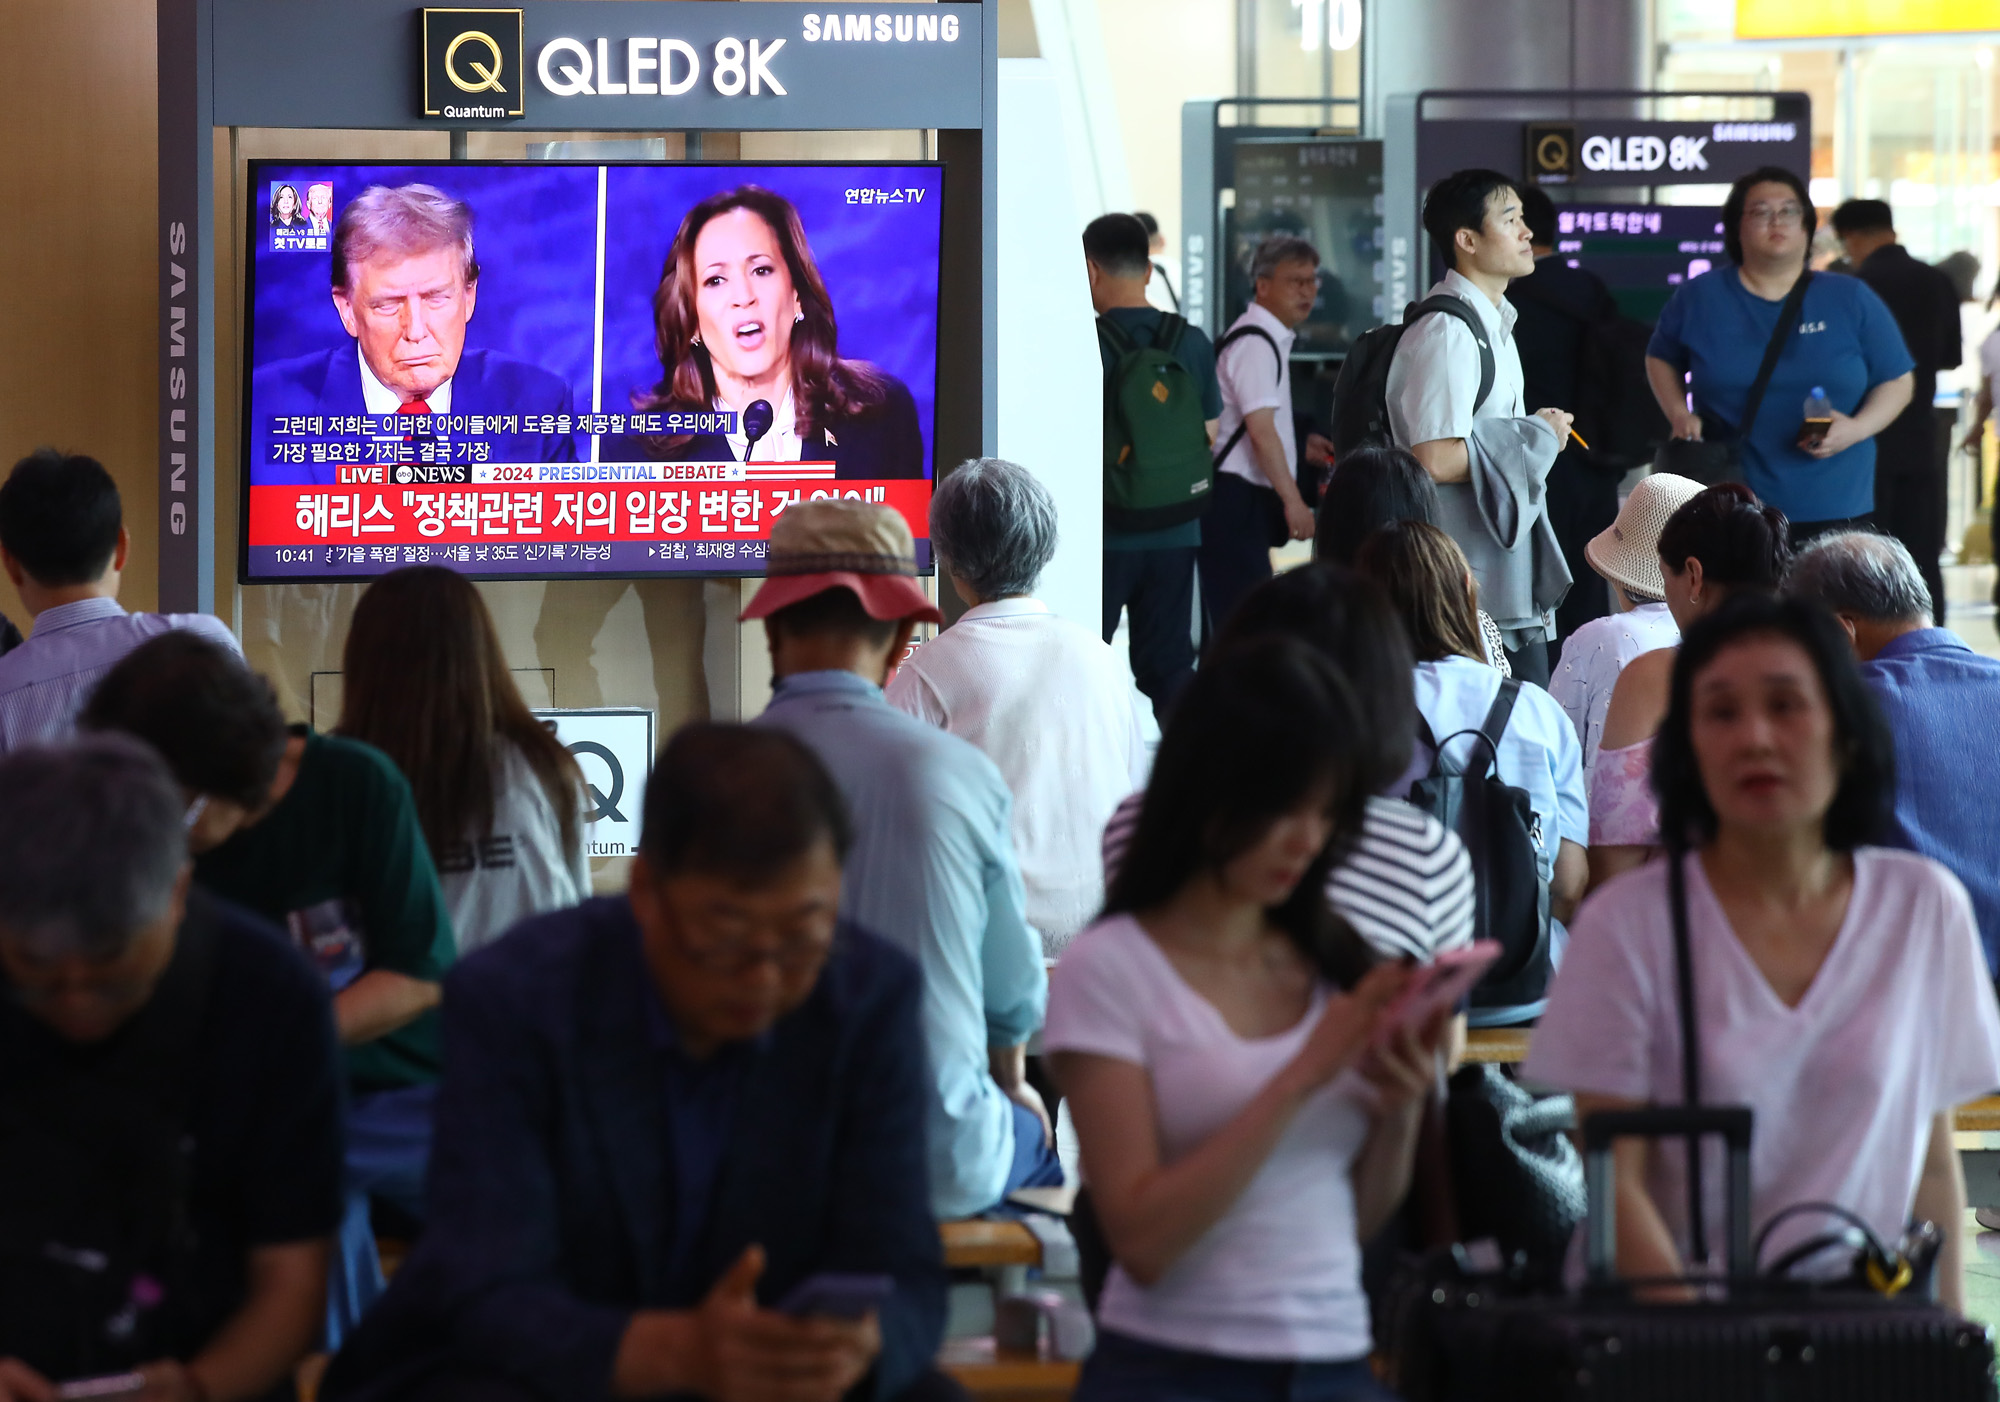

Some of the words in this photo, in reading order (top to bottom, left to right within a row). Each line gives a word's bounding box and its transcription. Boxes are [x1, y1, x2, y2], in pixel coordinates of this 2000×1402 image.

[802, 13, 960, 42] SAMSUNG
[444, 30, 508, 94] Q
[537, 37, 700, 97] QLED
[712, 37, 788, 97] 8K
[443, 105, 506, 119] Quantum
[1712, 122, 1797, 142] SAMSUNG
[1581, 135, 1667, 171] QLED
[1668, 135, 1709, 171] 8K
[844, 188, 926, 204] 연합뉴스TV
[169, 221, 186, 535] SAMSUNG
[272, 416, 323, 436] 그런데
[327, 416, 378, 435] 저희는
[382, 415, 433, 435] 이러한
[436, 414, 518, 435] 아이들에게
[522, 415, 573, 434] 도움을
[576, 414, 626, 434] 제공할
[630, 414, 663, 433] 때도
[666, 413, 732, 433] 우리에게
[272, 443, 306, 463] 가장
[310, 442, 361, 463] 필요한
[364, 442, 415, 462] 가치는
[419, 442, 452, 462] 결국
[456, 441, 491, 462] 가장
[341, 467, 384, 484] LIVE
[413, 466, 466, 483] NEWS
[493, 466, 534, 481] 2024
[539, 465, 657, 481] PRESIDENTIAL
[663, 465, 727, 480] DEBATE
[295, 493, 396, 538] 해리스
[401, 490, 544, 538] "정책관련
[551, 490, 617, 535] 저의
[625, 490, 692, 534] 입장
[699, 489, 764, 533] 변한
[275, 549, 314, 563] 10:41
[475, 545, 490, 562] 낮
[491, 546, 519, 561] 35도
[571, 544, 611, 560] 가능성
[659, 543, 690, 560] 검찰,
[738, 543, 770, 559] 수심
